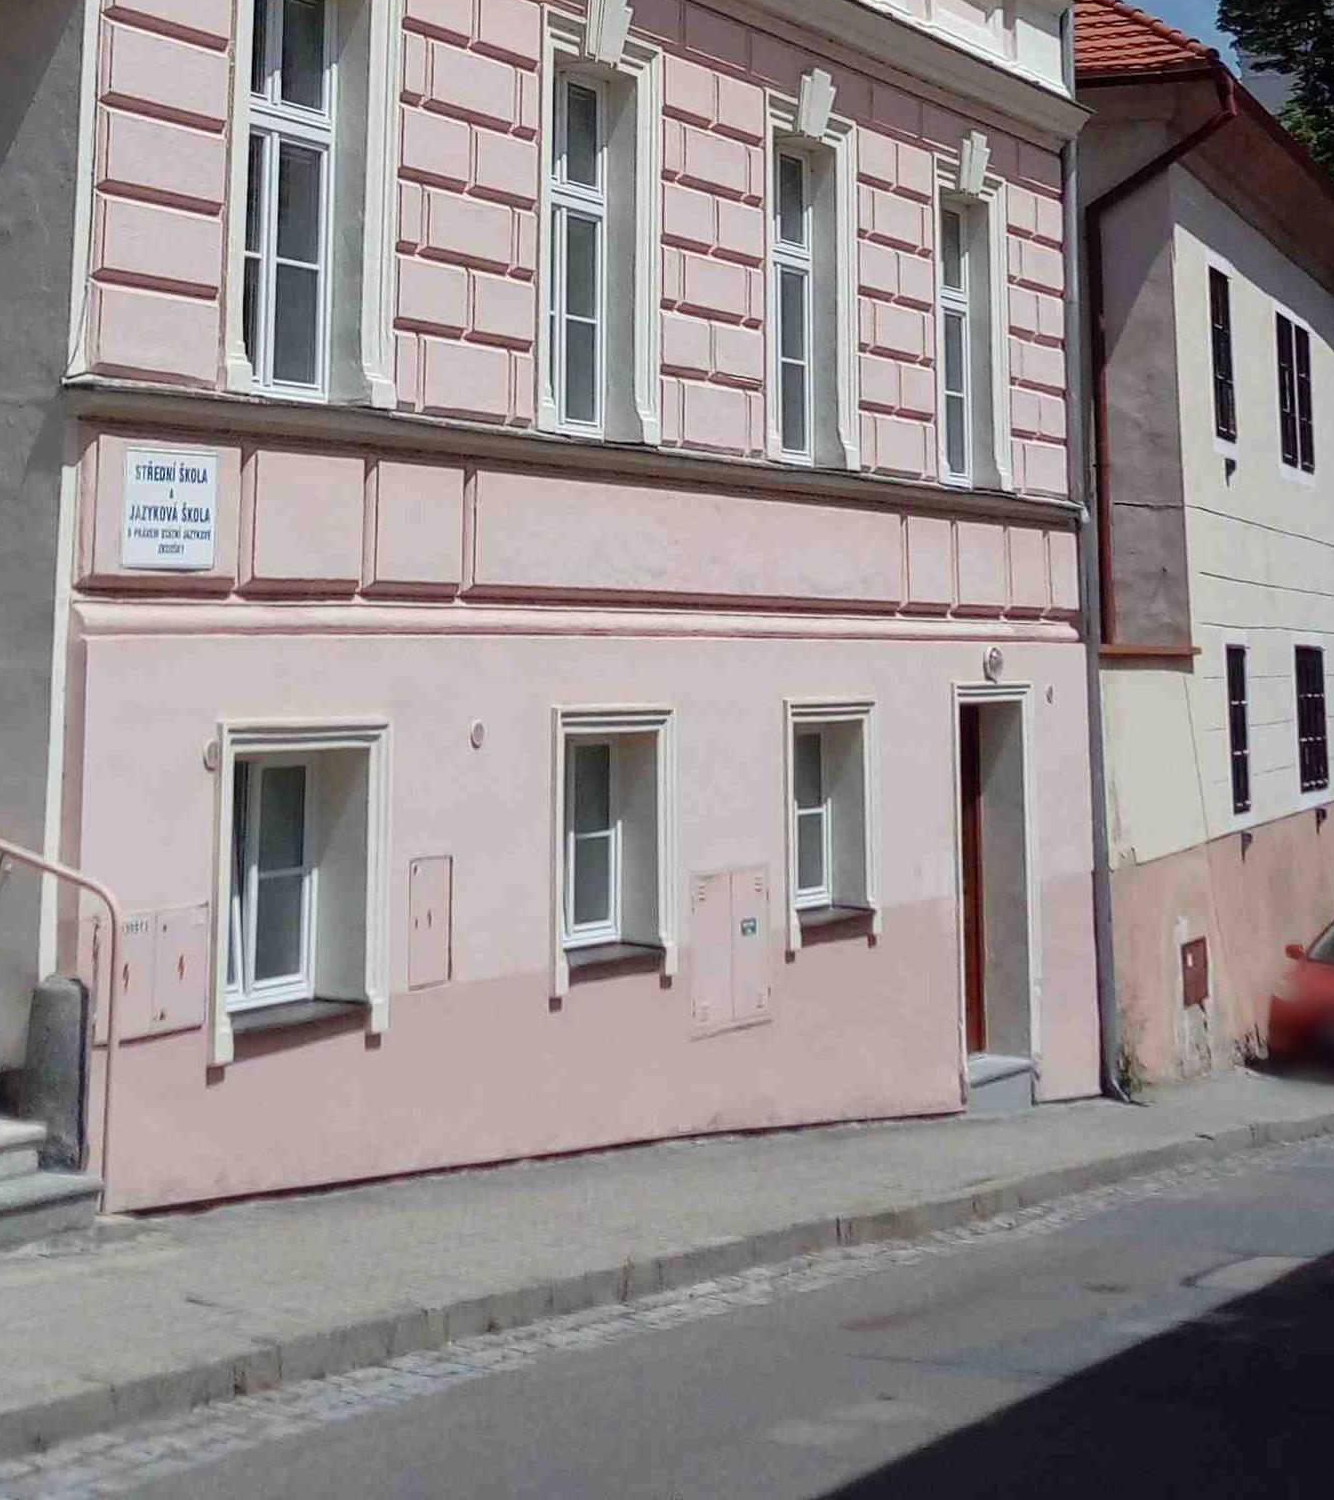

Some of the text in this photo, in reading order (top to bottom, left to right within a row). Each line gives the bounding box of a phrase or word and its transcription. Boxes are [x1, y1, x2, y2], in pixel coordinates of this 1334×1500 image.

[135, 461, 208, 483] STŘEDNÍ ŠKOLA
[169, 488, 174, 499] A
[130, 503, 211, 523] JAZYKOVÁ ŠKOLA
